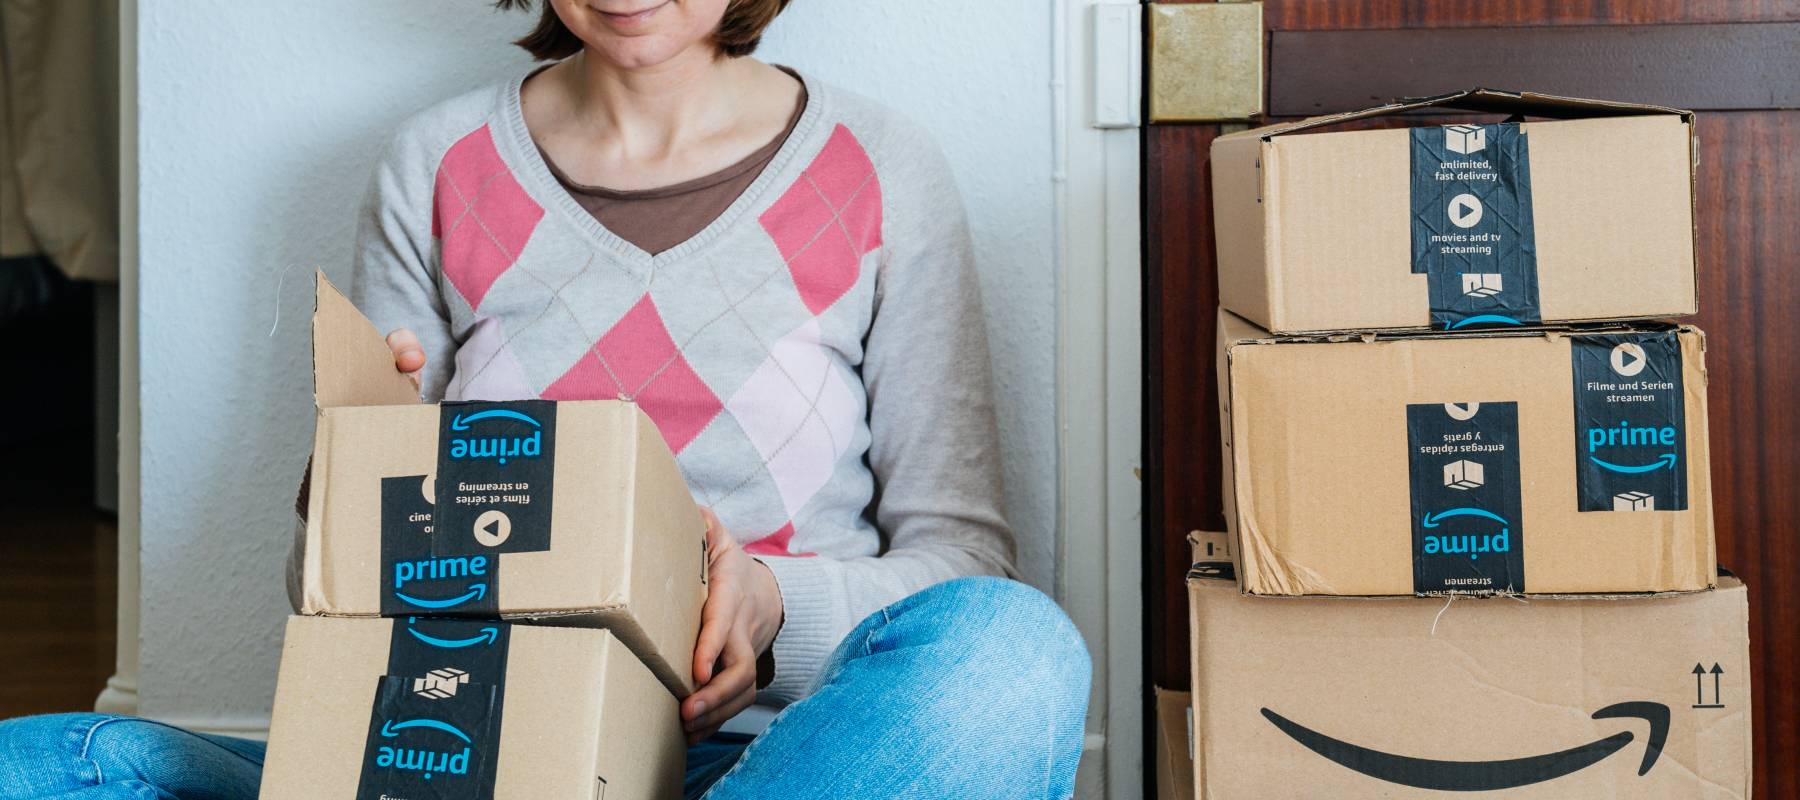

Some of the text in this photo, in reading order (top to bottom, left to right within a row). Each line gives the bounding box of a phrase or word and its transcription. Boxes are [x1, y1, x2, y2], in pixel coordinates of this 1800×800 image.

[1440, 160, 1492, 169] unlimited,
[1435, 171, 1498, 181] fast delivery
[1431, 234, 1467, 242] movies
[1469, 233, 1488, 242] and
[1441, 245, 1492, 255] streaming
[1587, 381, 1674, 391] Filme und Serien
[1606, 393, 1655, 402] streamen
[1443, 432, 1481, 443] y gratis
[1589, 421, 1676, 452] prime
[449, 431, 541, 464] prime
[1420, 443, 1504, 454] entregas rápidas
[459, 482, 512, 493] streaming
[456, 495, 530, 505] films et séries
[409, 512, 432, 522] cine
[1424, 528, 1509, 560] prime
[395, 556, 487, 588] prime
[1444, 577, 1492, 586] streamen
[376, 746, 470, 780] prime
